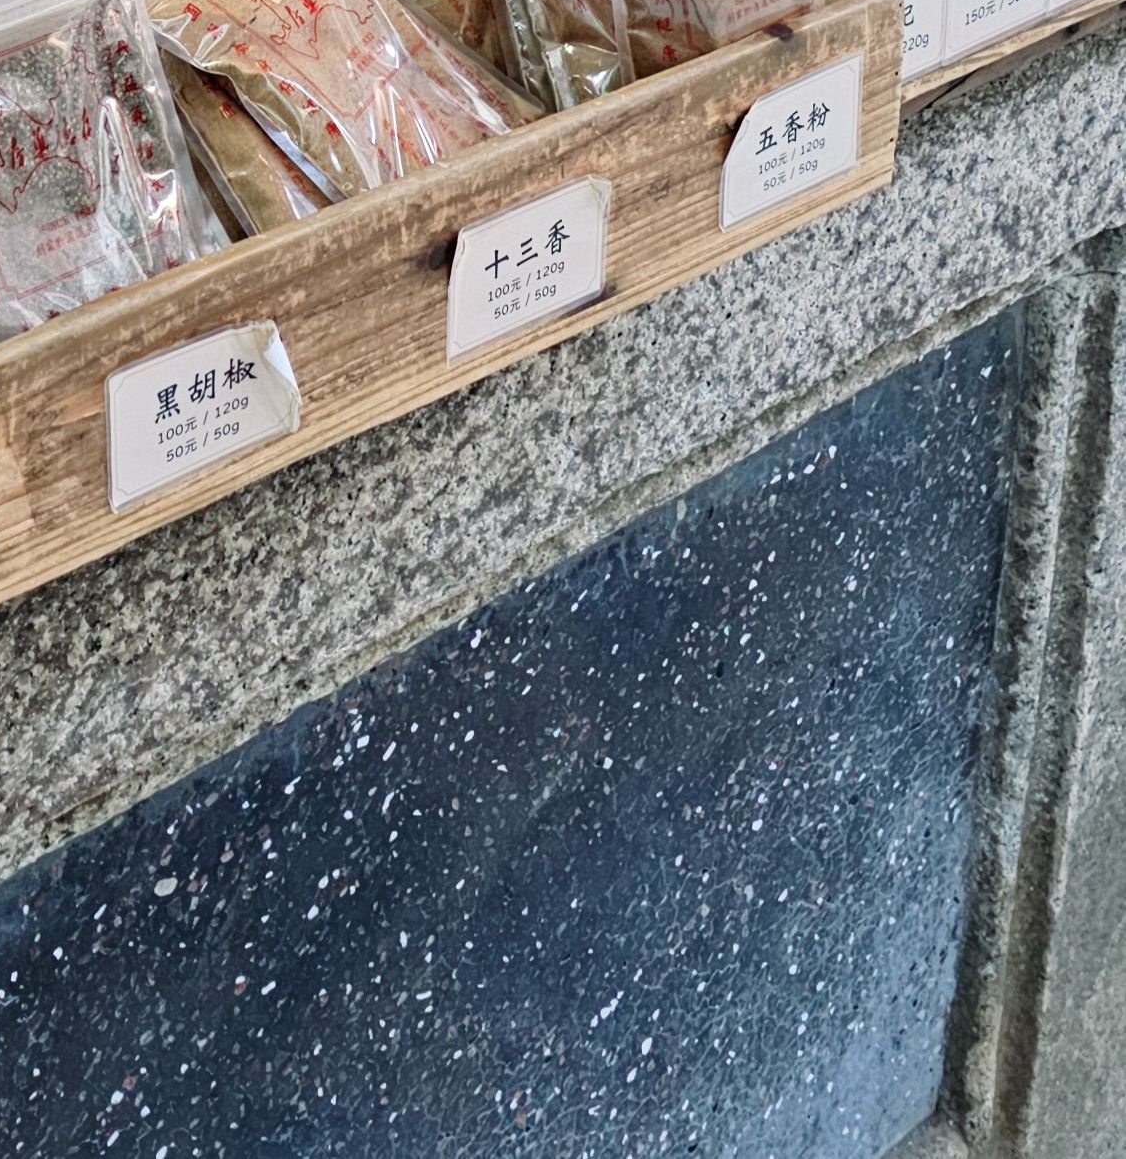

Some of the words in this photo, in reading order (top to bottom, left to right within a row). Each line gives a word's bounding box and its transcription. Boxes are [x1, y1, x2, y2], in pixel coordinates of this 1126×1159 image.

[965, 0, 996, 26] 150元
[755, 102, 831, 156] 五香粉
[758, 151, 788, 176] 100元
[800, 137, 826, 156] 120g
[763, 171, 787, 191] 50元
[798, 159, 818, 176] 50g
[484, 219, 571, 279] 十三香
[488, 276, 522, 303] 100元
[535, 261, 565, 282] 120g
[494, 297, 521, 319] 50元
[534, 284, 557, 302] 50g
[154, 357, 258, 424] 黑胡椒
[157, 415, 198, 445] 100元
[214, 396, 249, 419] 120g
[166, 437, 198, 463] 50元
[213, 421, 240, 441] 50g
